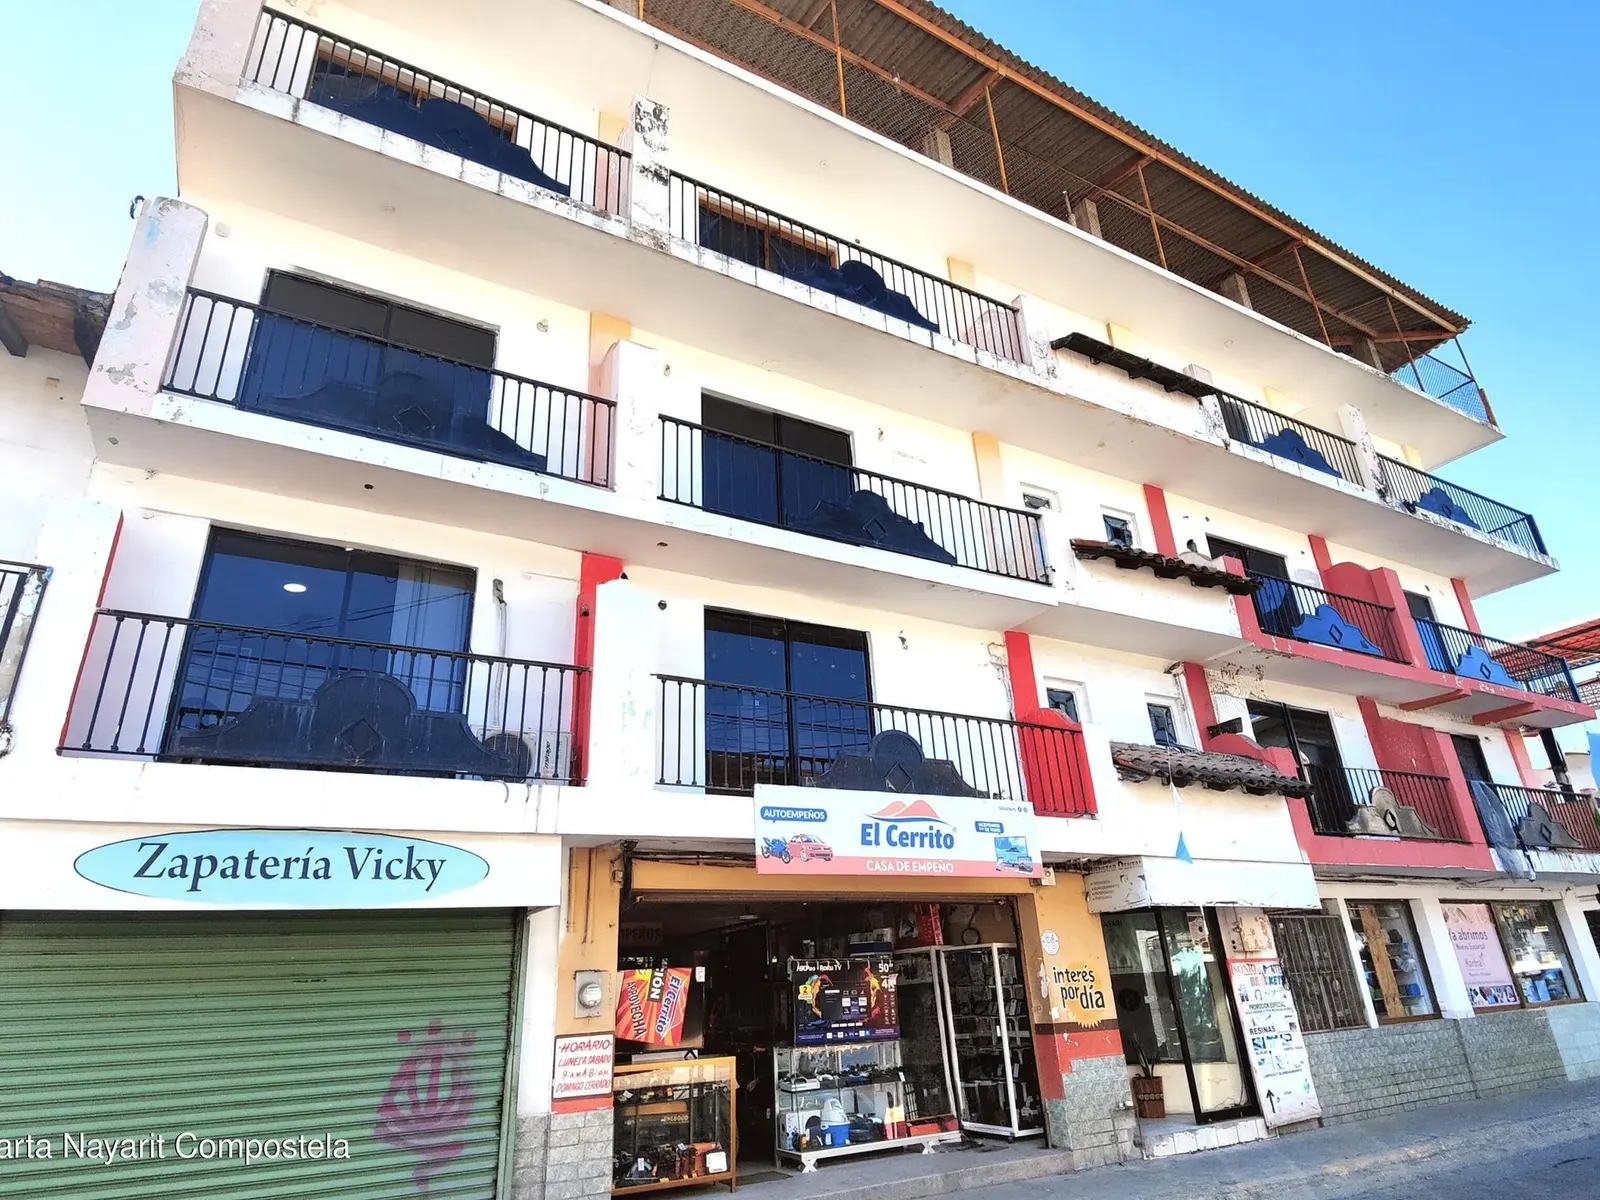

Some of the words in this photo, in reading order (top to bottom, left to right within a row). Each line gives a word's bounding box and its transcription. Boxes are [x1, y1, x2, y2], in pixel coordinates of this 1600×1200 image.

[763, 808, 825, 820] AUTOEMPEÑOS
[861, 822, 879, 847] El
[886, 824, 955, 849] Cerrito
[133, 842, 332, 892] Zapatería
[343, 845, 447, 892] Vicky
[866, 860, 894, 872] CASA
[896, 861, 910, 872] DE
[912, 861, 954, 873] EMPEÑO
[1458, 928, 1489, 940] abrimos
[670, 976, 681, 990] El
[1053, 965, 1095, 984] interés
[1060, 986, 1079, 1008] por
[1080, 985, 1106, 1009] día
[627, 981, 648, 1039] APROVECHA
[656, 989, 676, 1033] Cerrito
[1249, 1025, 1276, 1035] RESINAS
